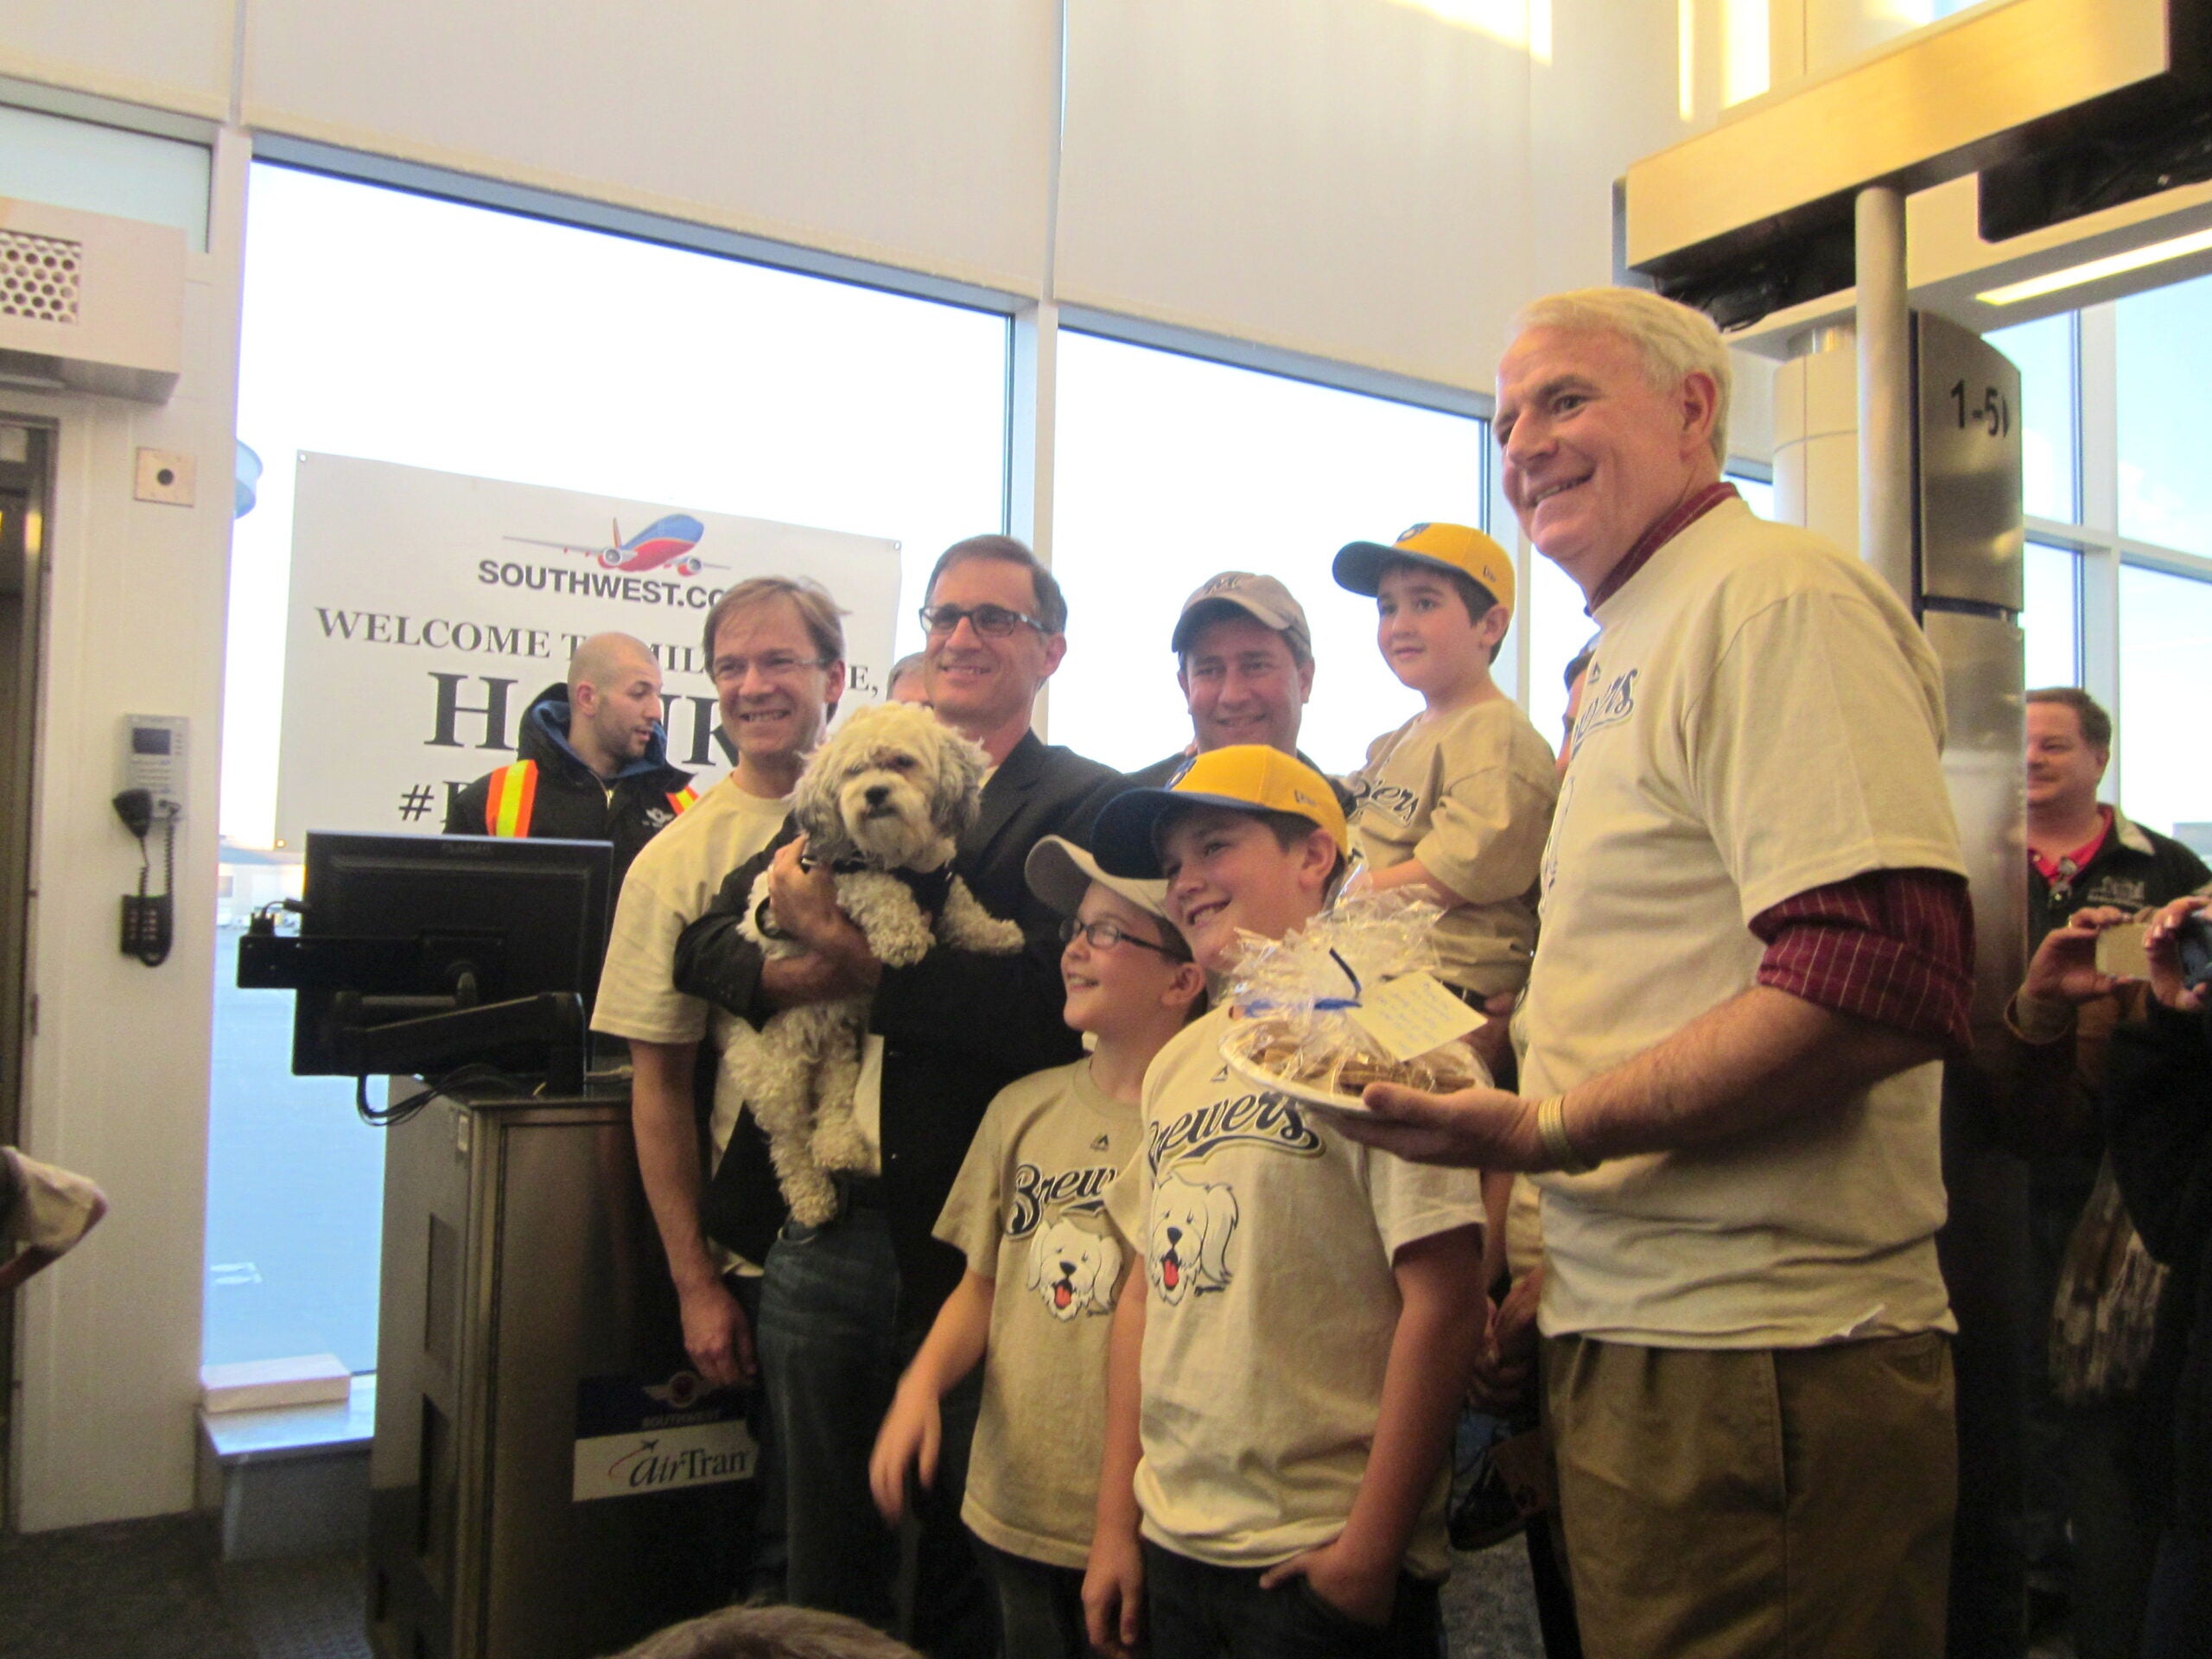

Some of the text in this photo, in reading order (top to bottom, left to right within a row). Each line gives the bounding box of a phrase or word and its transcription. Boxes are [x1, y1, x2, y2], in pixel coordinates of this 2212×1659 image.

[477, 559, 726, 609] SOUTHWEST.CO
[315, 607, 551, 659] WELCOME
[423, 671, 739, 767] HK
[1006, 1164, 1116, 1236] Brew
